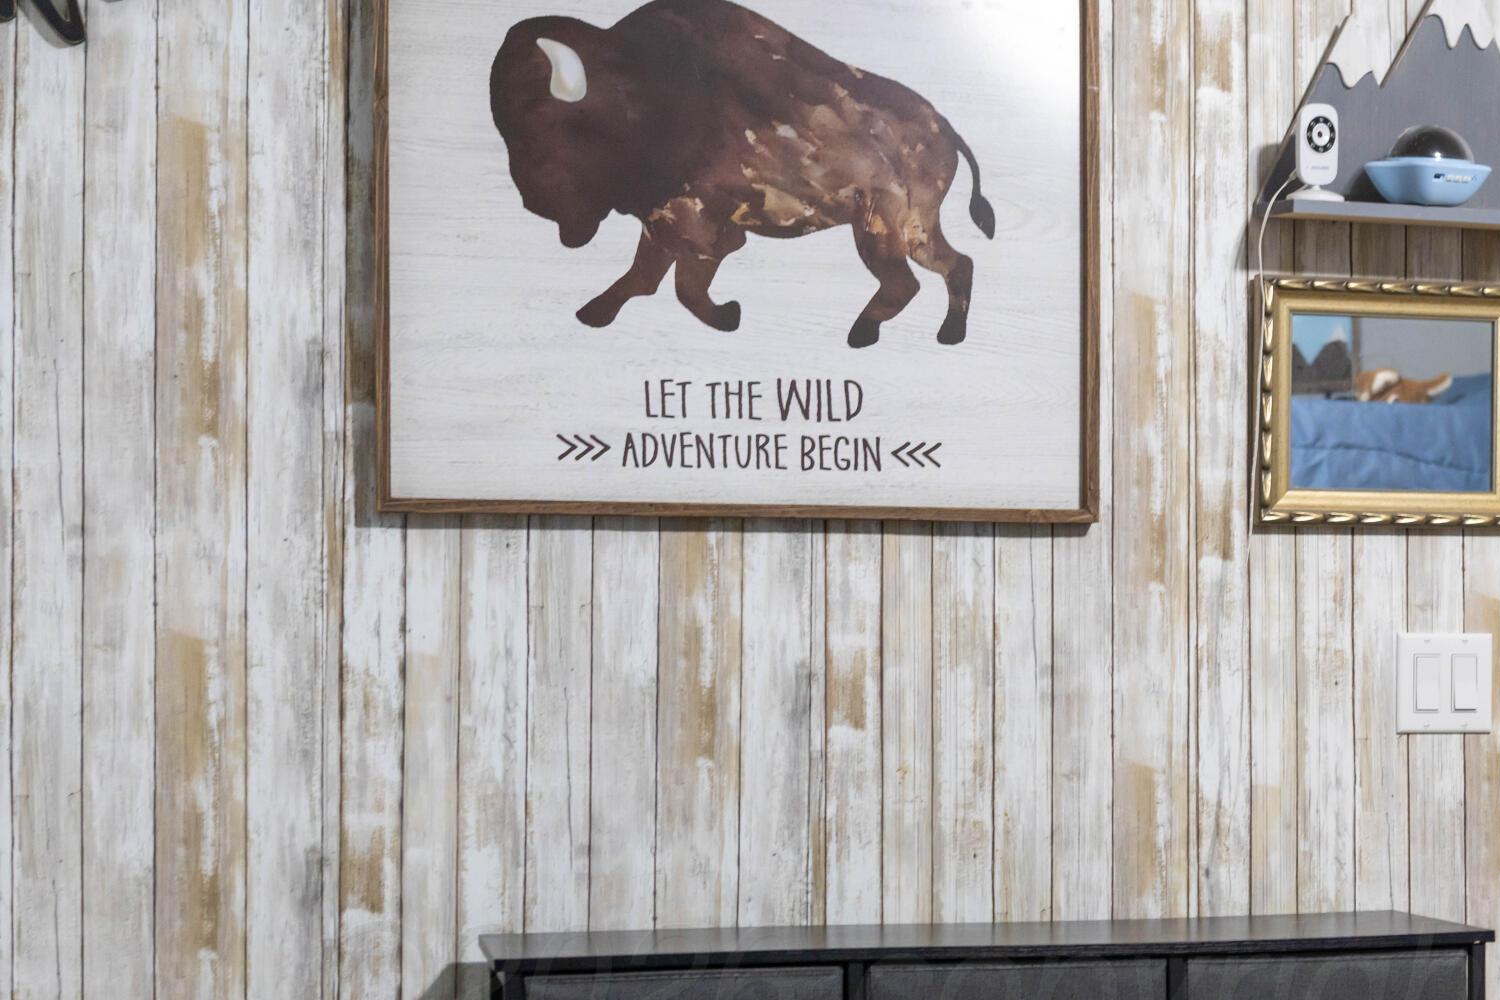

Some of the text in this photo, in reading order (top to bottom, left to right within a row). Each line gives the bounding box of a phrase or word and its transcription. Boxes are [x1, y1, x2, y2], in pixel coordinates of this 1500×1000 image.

[643, 377, 864, 422] LET THE WILD
[621, 431, 883, 472] ADVENTURE BEGIN
